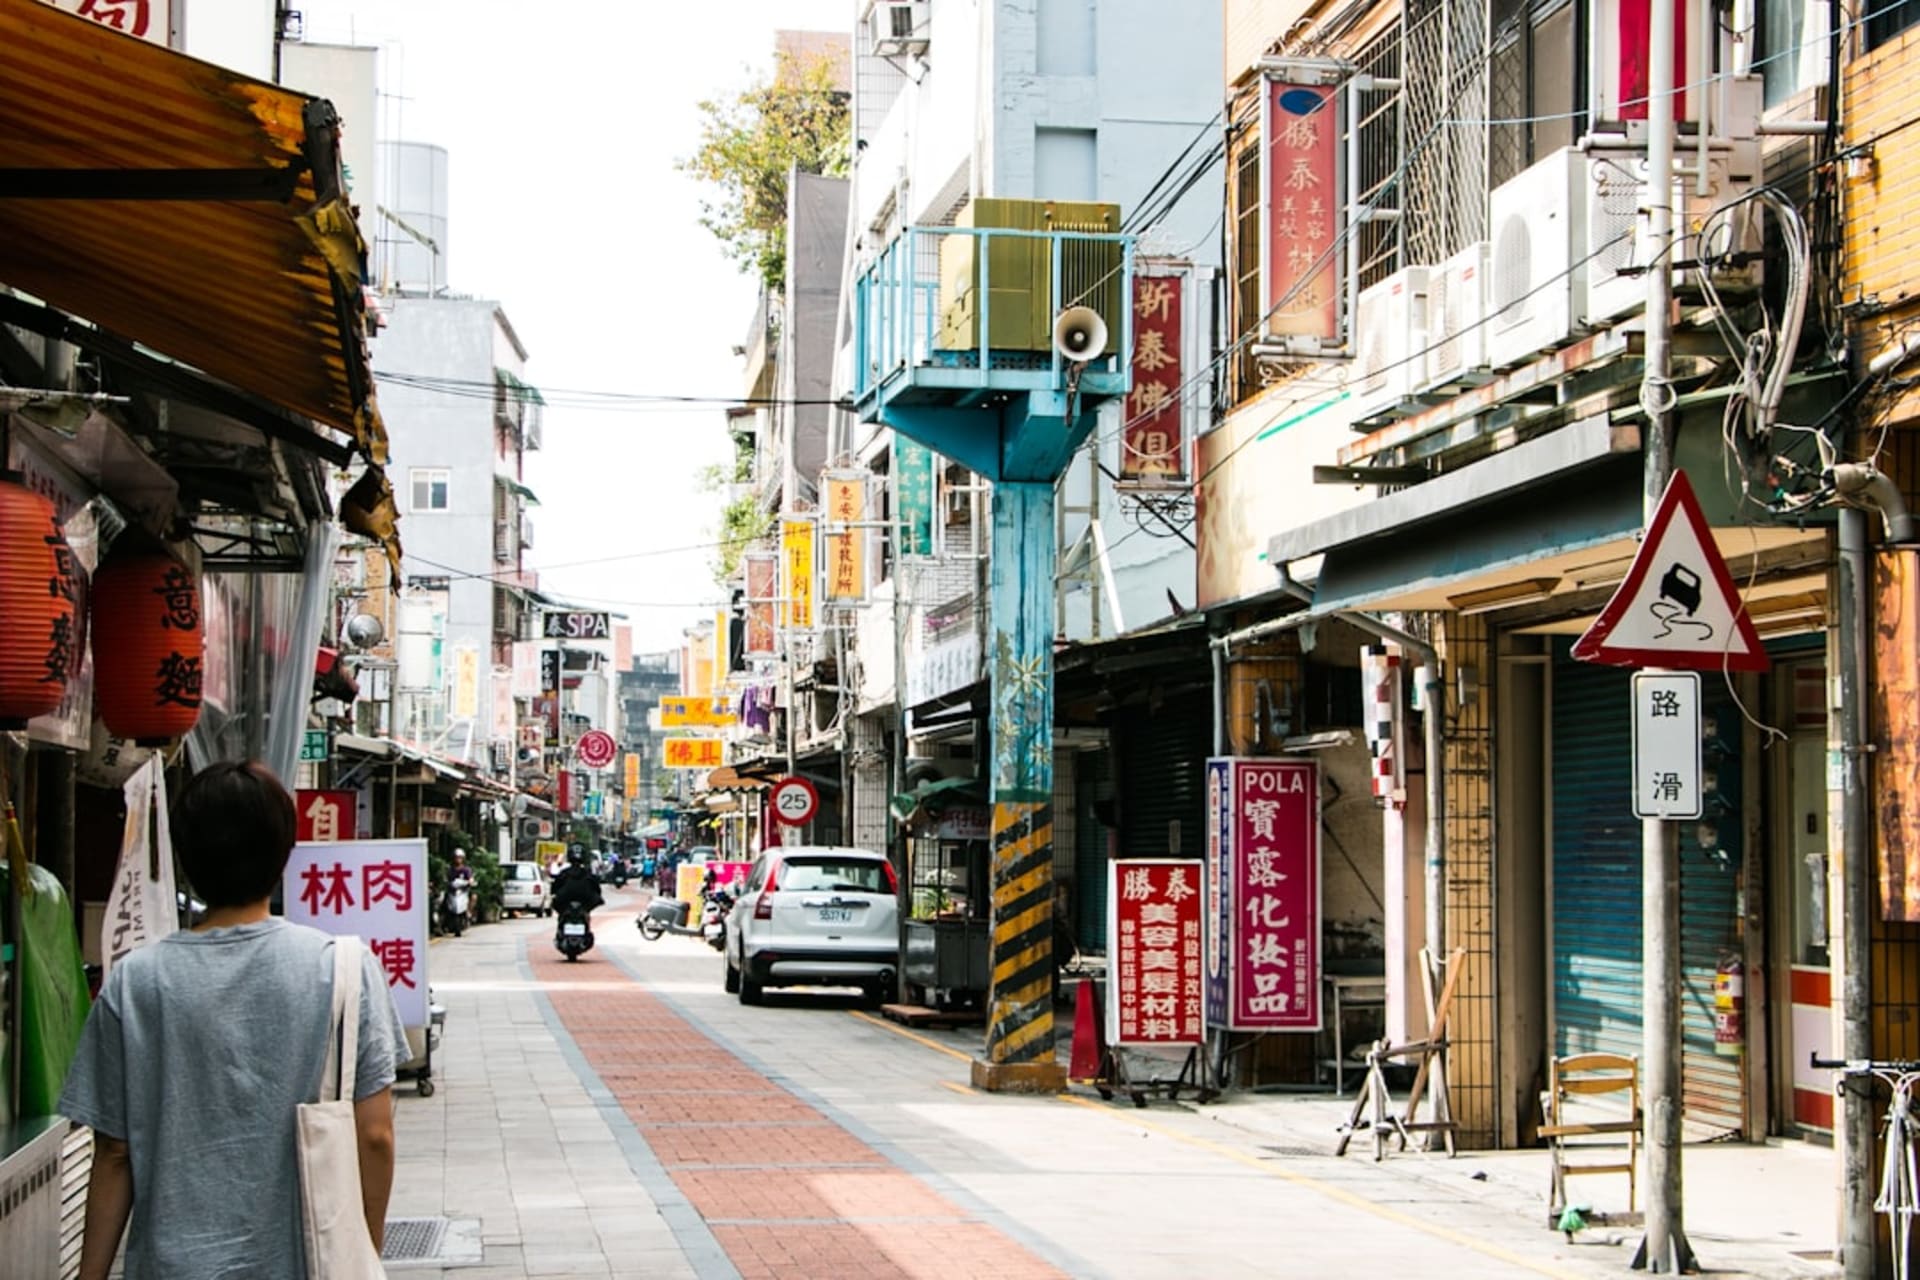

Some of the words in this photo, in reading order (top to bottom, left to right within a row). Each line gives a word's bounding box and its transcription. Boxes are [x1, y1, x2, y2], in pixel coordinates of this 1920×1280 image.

[154, 566, 203, 709] 意麵
[566, 613, 609, 637] SPA
[1244, 771, 1304, 794] POLA
[1651, 690, 1683, 801] 路滑
[781, 793, 807, 810] 25
[1122, 866, 1197, 903] 勝泰
[1244, 798, 1290, 1015] 寶露化妝品
[1140, 902, 1179, 1040] 美容美髮材料
